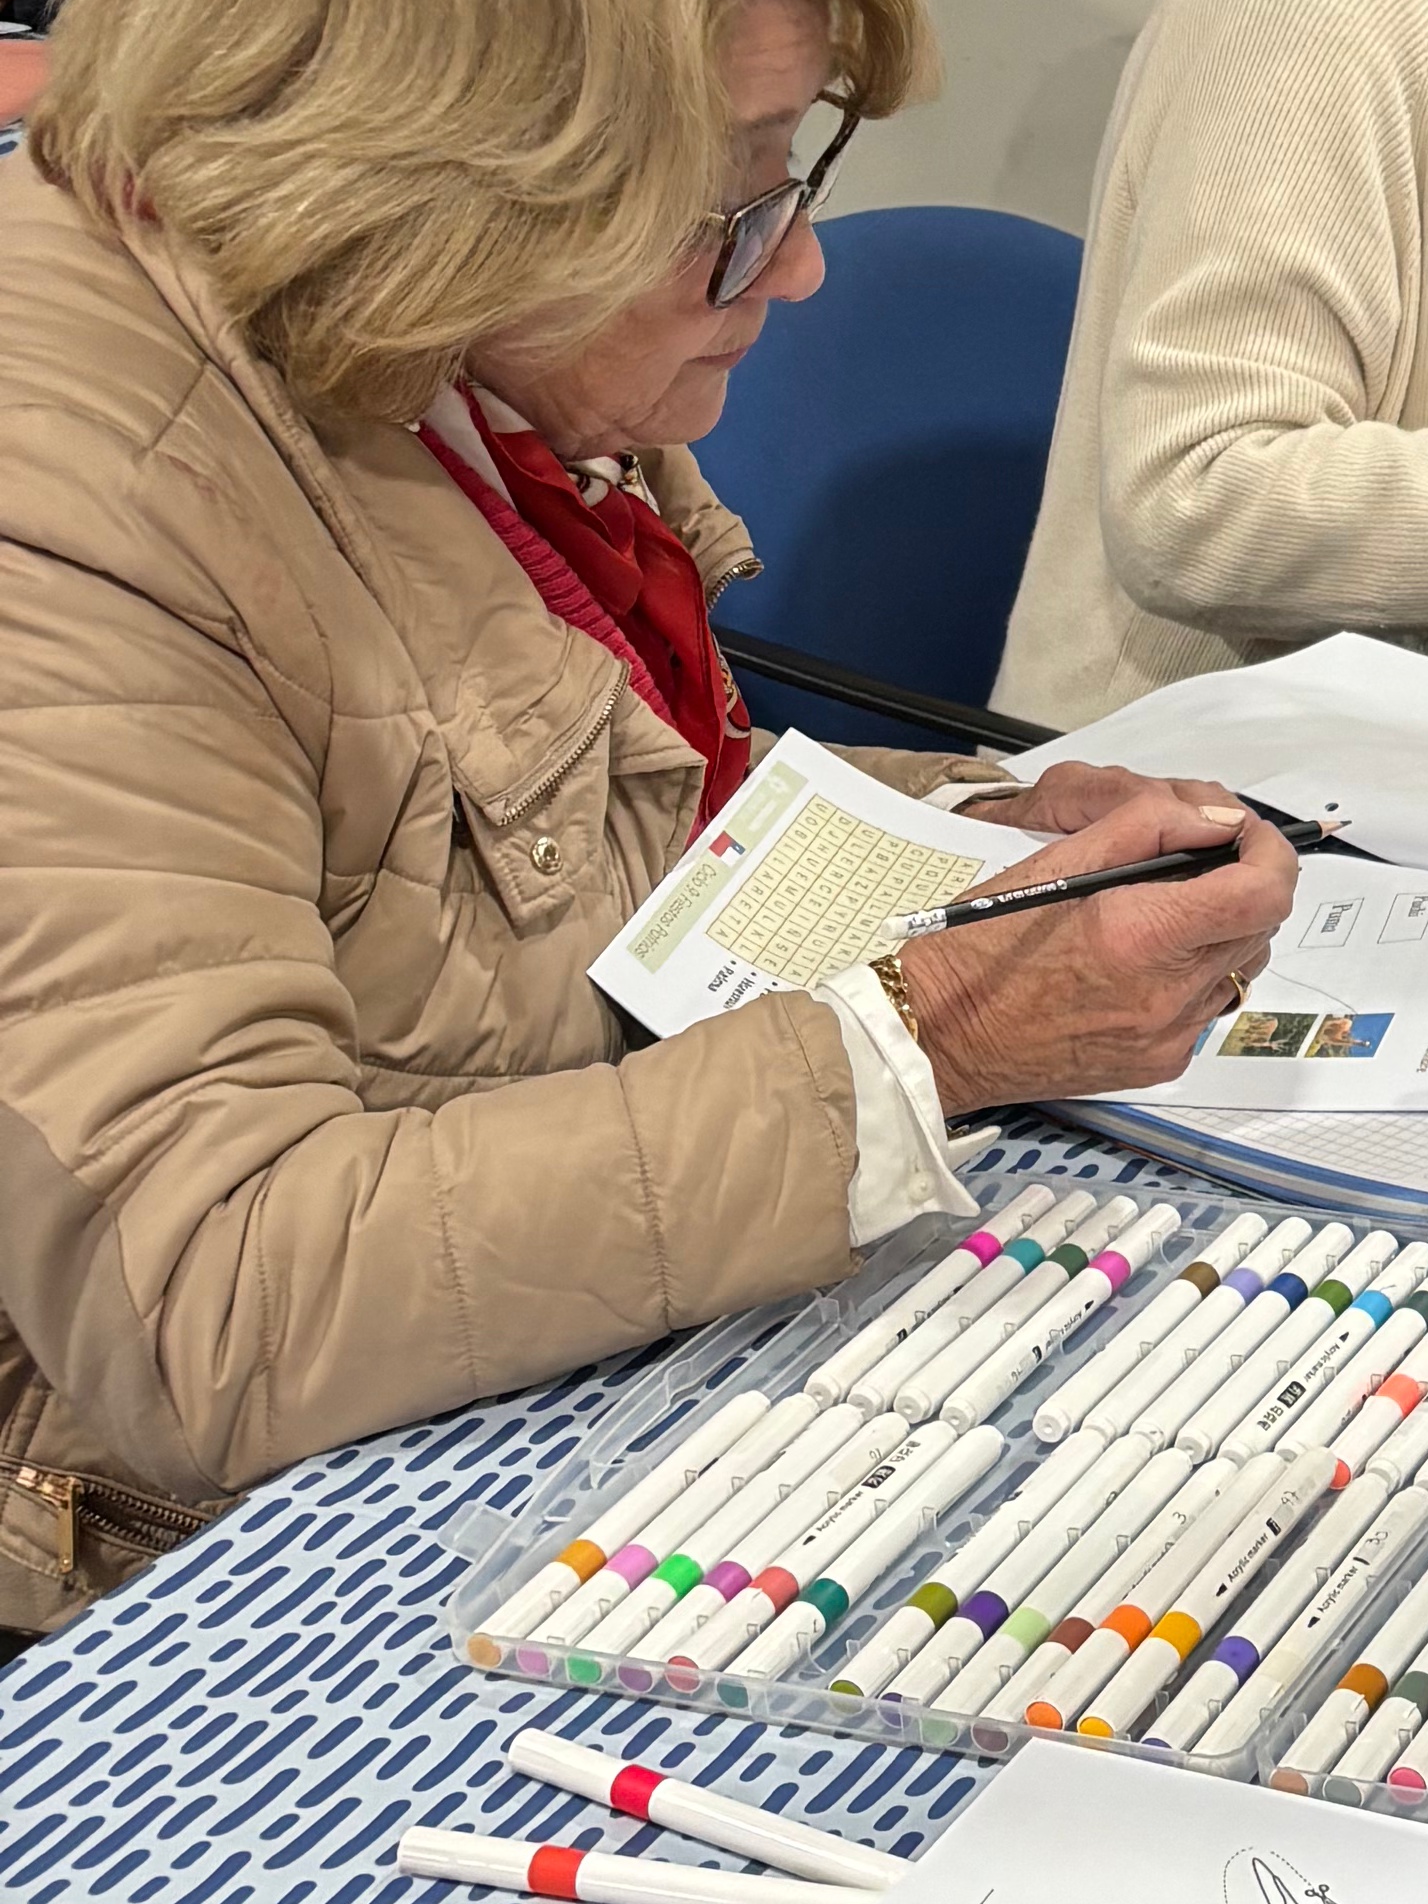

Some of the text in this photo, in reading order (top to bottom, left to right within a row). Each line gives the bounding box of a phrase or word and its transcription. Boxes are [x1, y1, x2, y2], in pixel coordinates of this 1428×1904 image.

[689, 861, 719, 891] Ciclo
[658, 892, 694, 928] Fiestas
[1320, 903, 1353, 933] Puma
[631, 922, 669, 960] Patrias
[1170, 1507, 1189, 1525] 3
